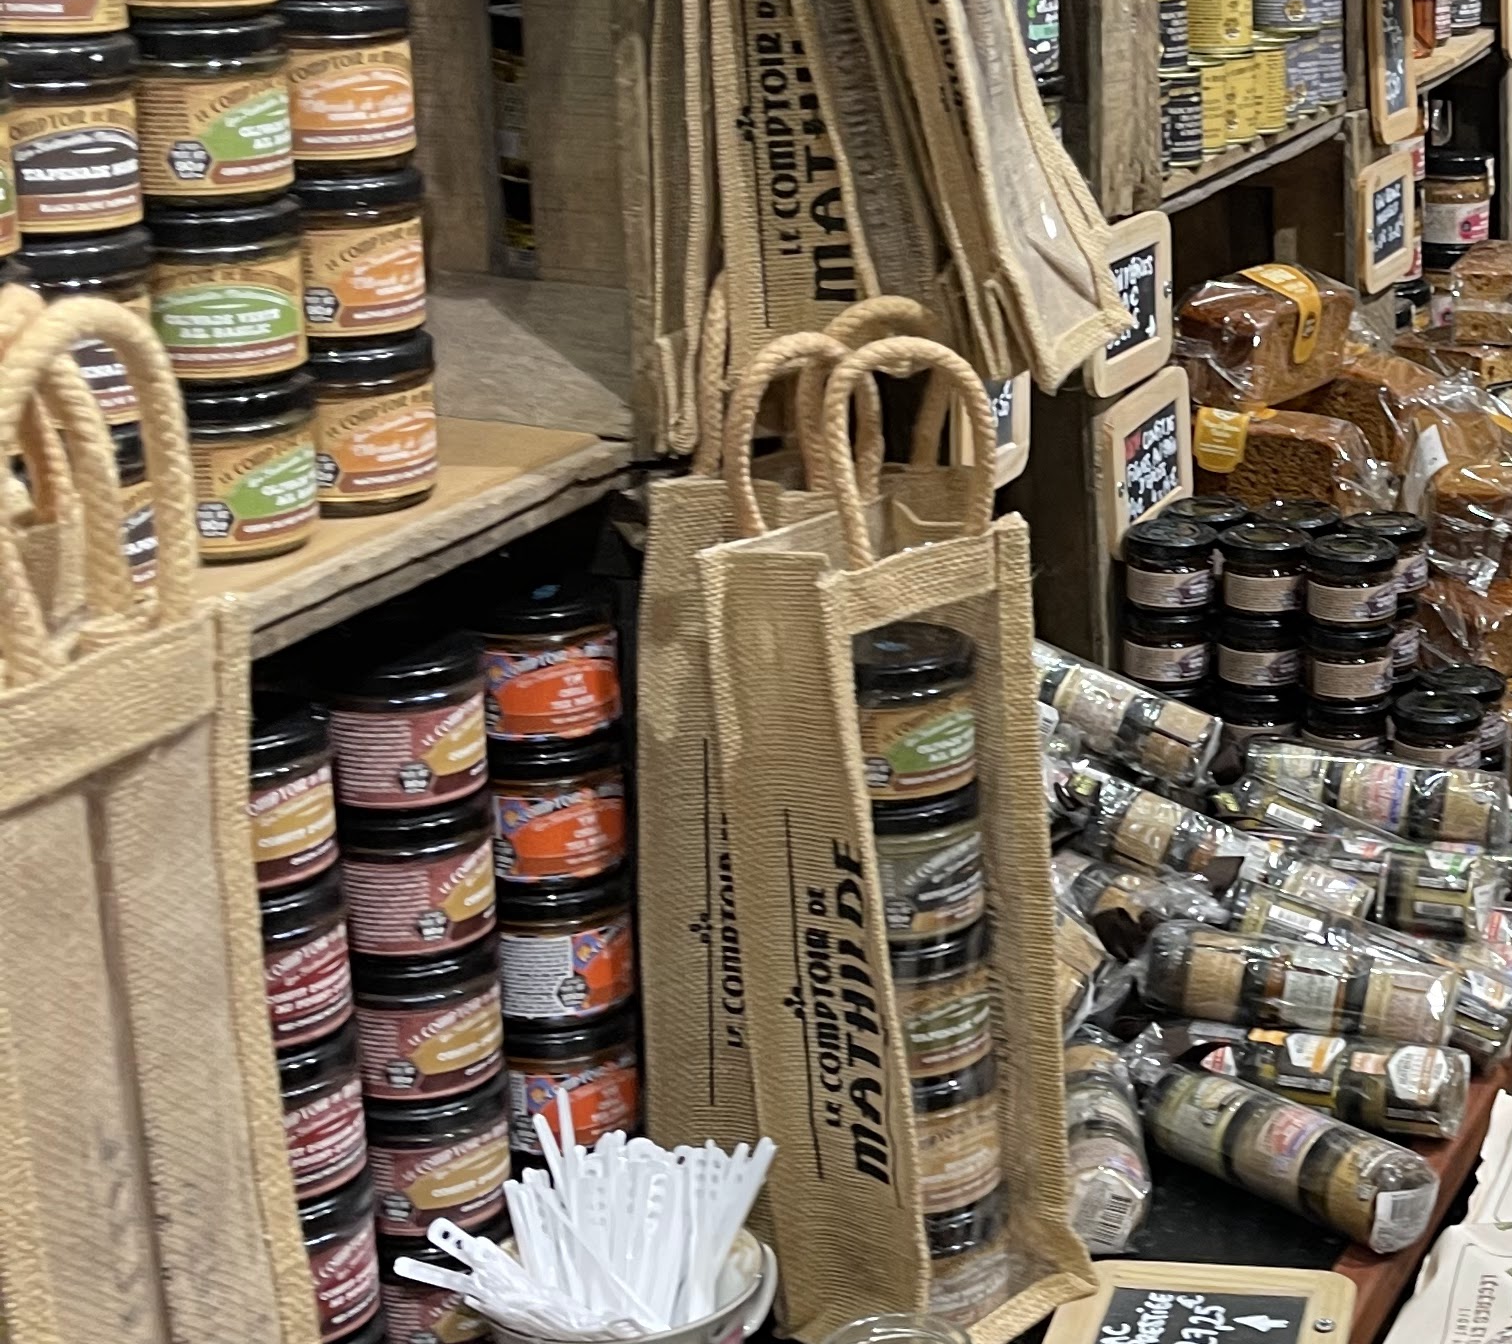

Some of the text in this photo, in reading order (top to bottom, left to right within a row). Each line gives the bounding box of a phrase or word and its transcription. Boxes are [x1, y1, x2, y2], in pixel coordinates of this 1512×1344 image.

[755, 30, 800, 221] COMPTOIR
[805, 925, 844, 1094] COMPTOIR
[831, 836, 891, 1186] MATHILDE
